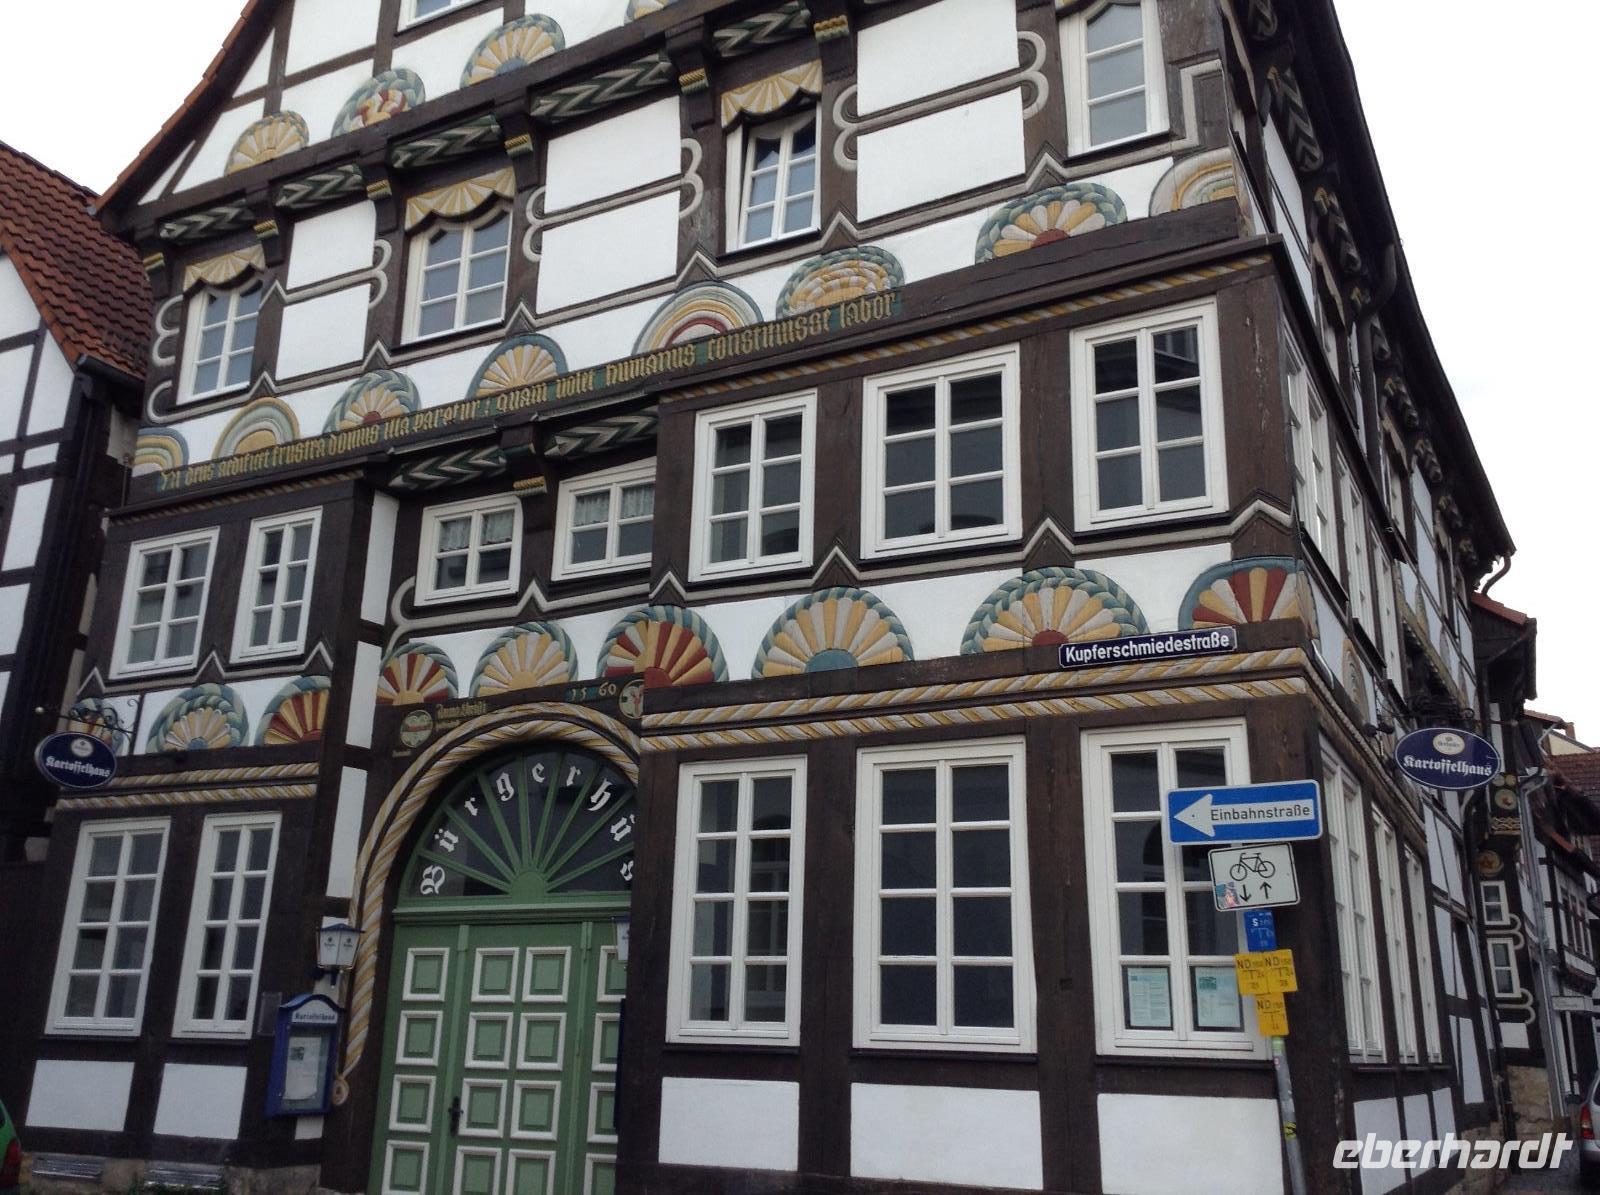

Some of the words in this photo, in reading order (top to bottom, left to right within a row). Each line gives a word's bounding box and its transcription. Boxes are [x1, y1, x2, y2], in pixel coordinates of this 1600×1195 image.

[272, 437, 325, 466] frustra
[328, 424, 380, 456] domus
[605, 343, 697, 387] humanus
[839, 292, 896, 329] labor
[1065, 632, 1230, 663] Kupferschmiedestraße
[45, 755, 111, 778] Kartoffelhaus
[1403, 755, 1493, 777] Kartoffelhaus
[1210, 804, 1311, 821] Einbahnstraße
